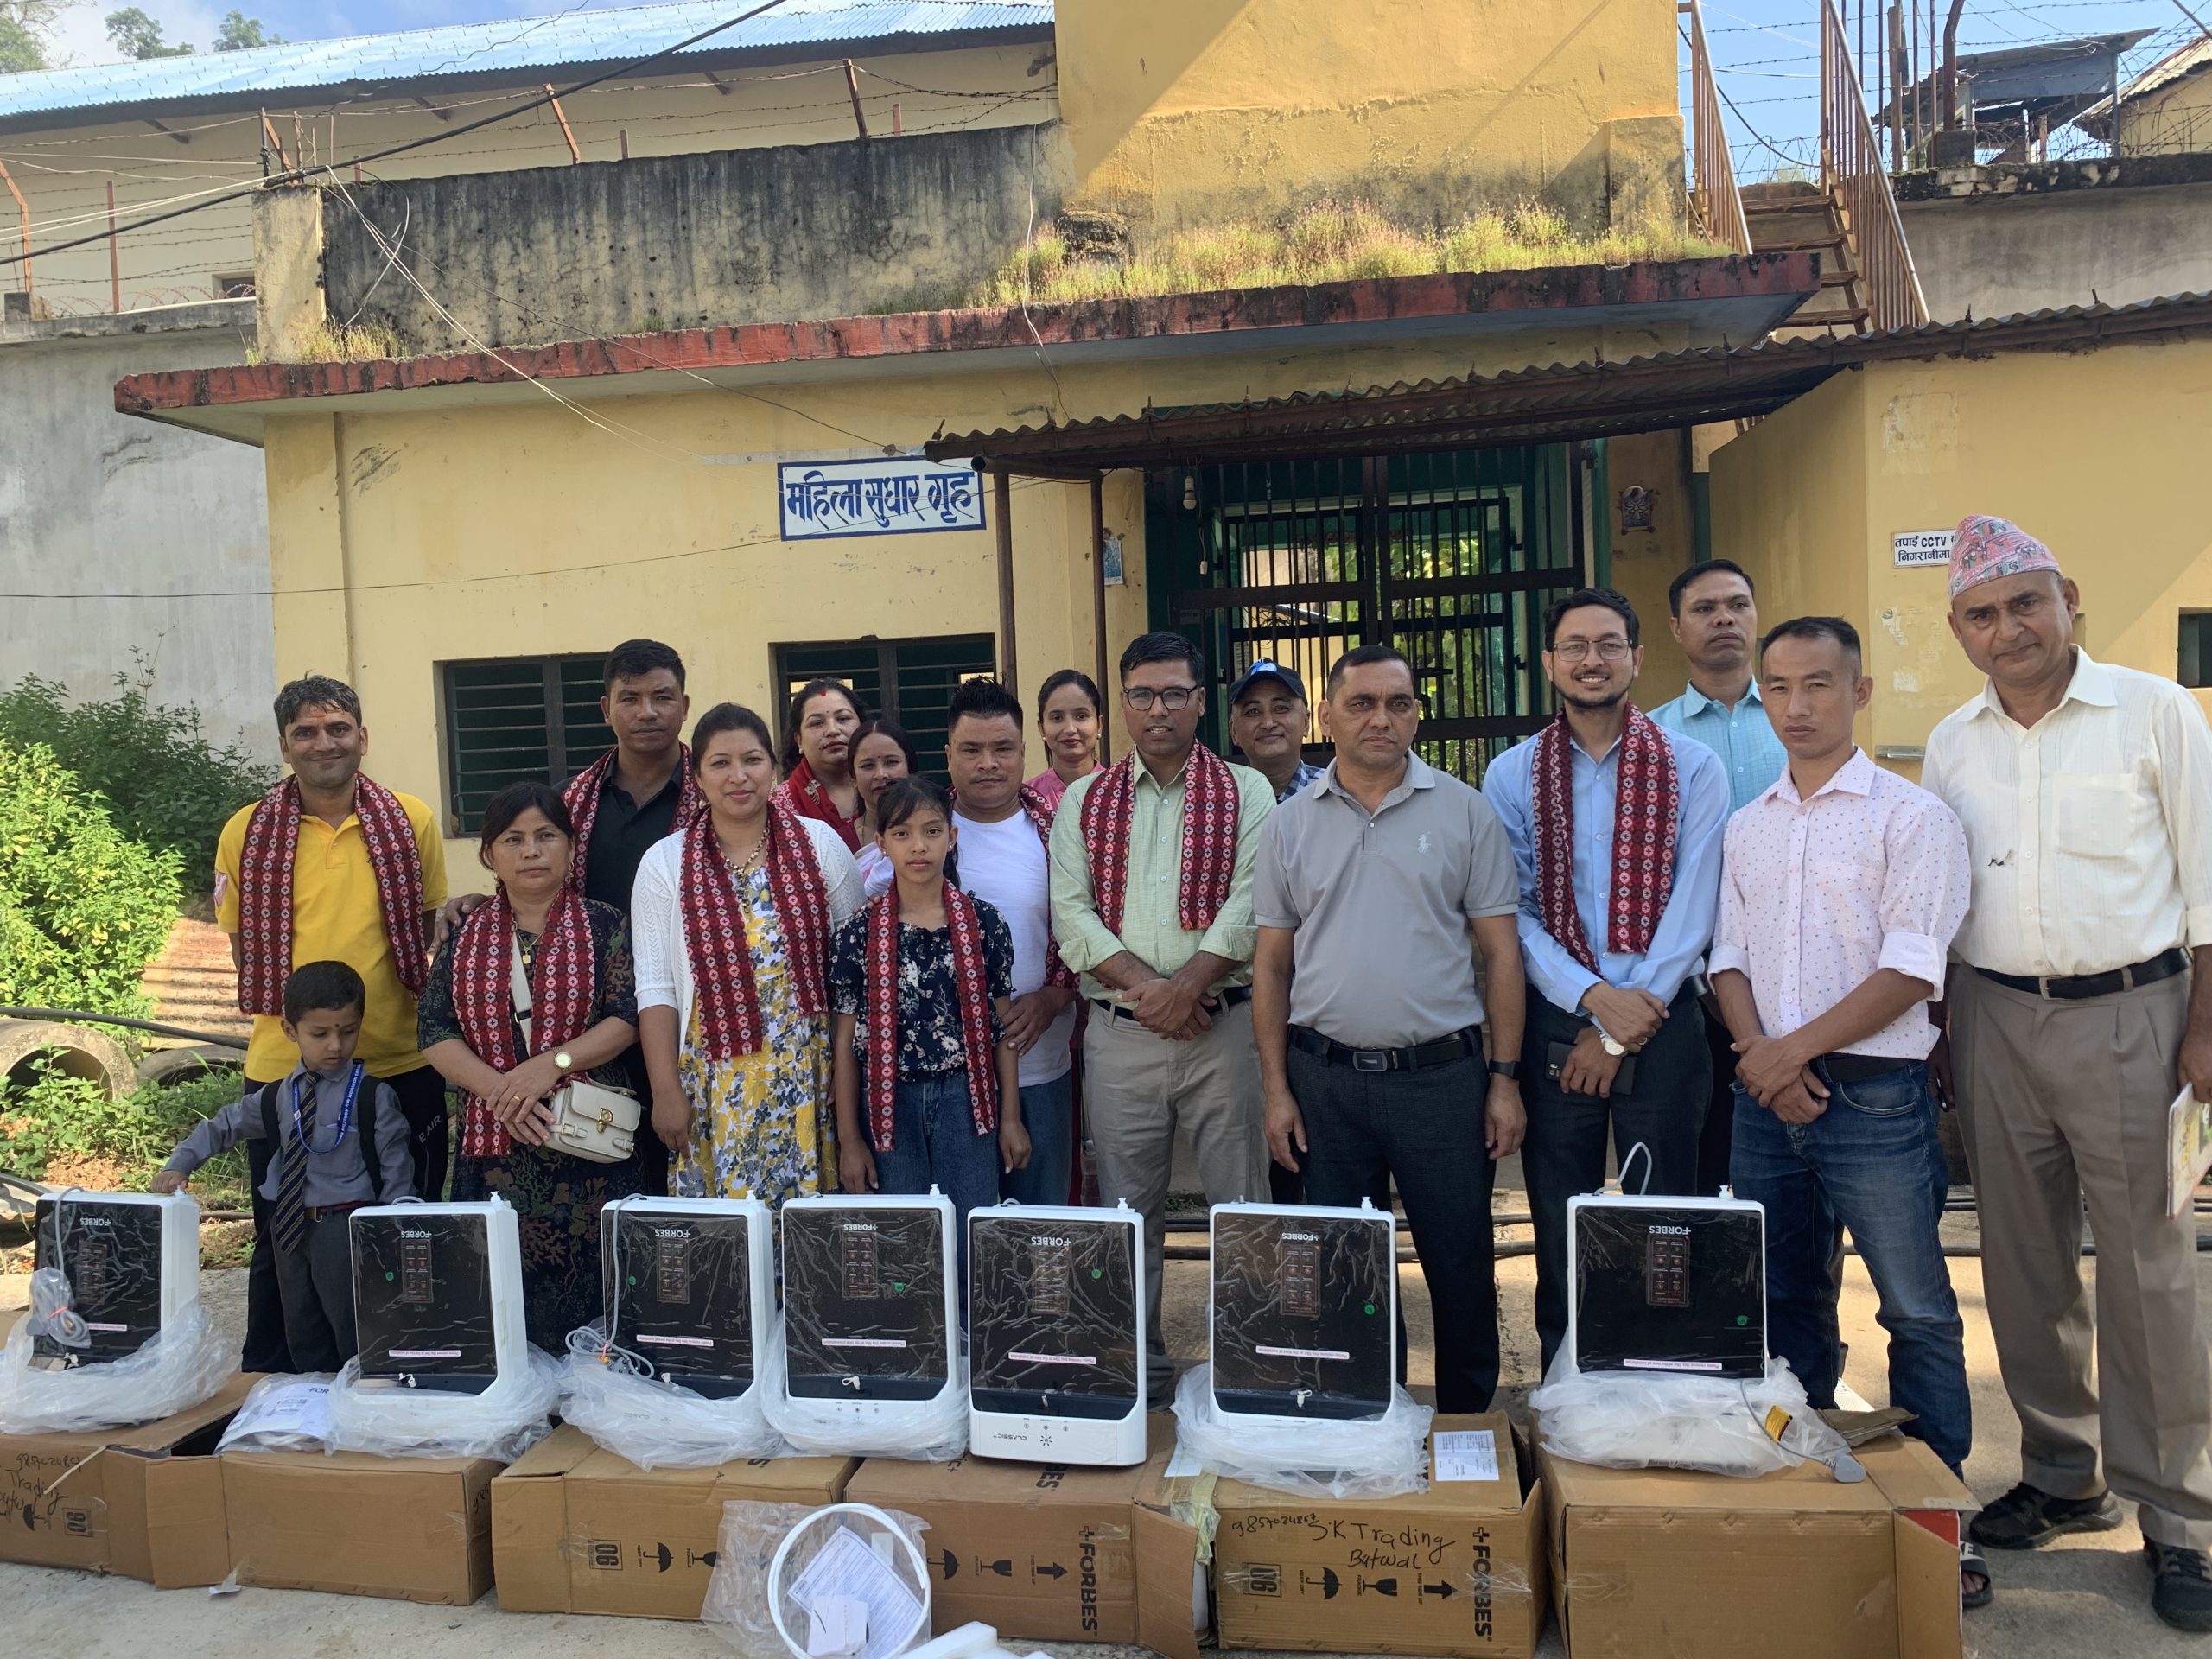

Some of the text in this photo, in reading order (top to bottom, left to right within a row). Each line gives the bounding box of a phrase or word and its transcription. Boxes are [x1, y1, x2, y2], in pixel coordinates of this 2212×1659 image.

[786, 470, 976, 530] महिला सुधार गृह
[1921, 537, 1946, 547] CCTV
[1897, 548, 1950, 562] निगरानीमा
[594, 1543, 620, 1567] 06
[1351, 1522, 1456, 1564] Trading
